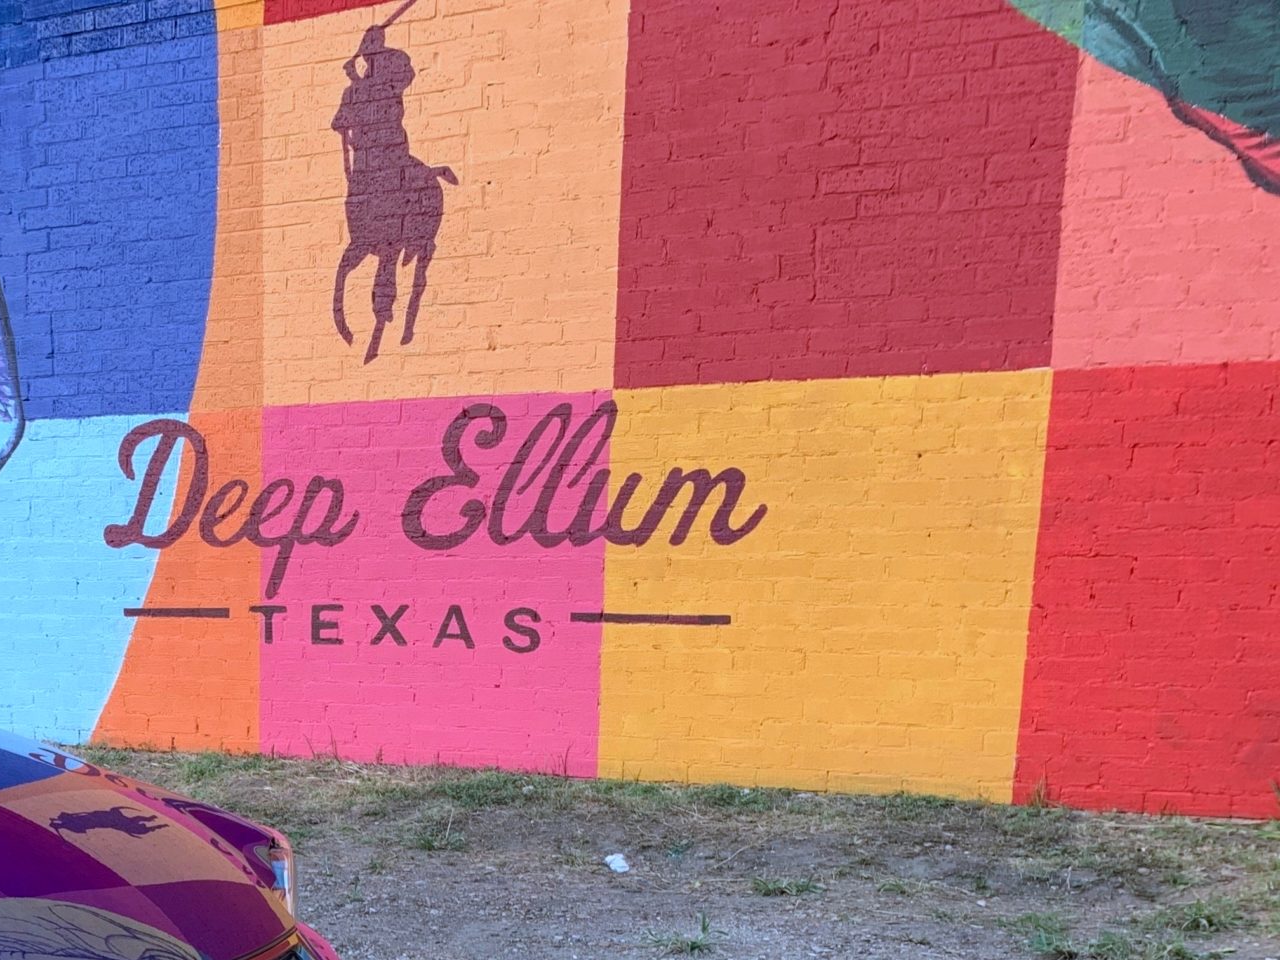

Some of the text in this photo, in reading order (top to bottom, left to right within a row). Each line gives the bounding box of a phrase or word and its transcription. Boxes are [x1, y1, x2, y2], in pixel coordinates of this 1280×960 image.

[103, 398, 768, 598] Deep Ellum
[248, 602, 542, 655] TEXAS
